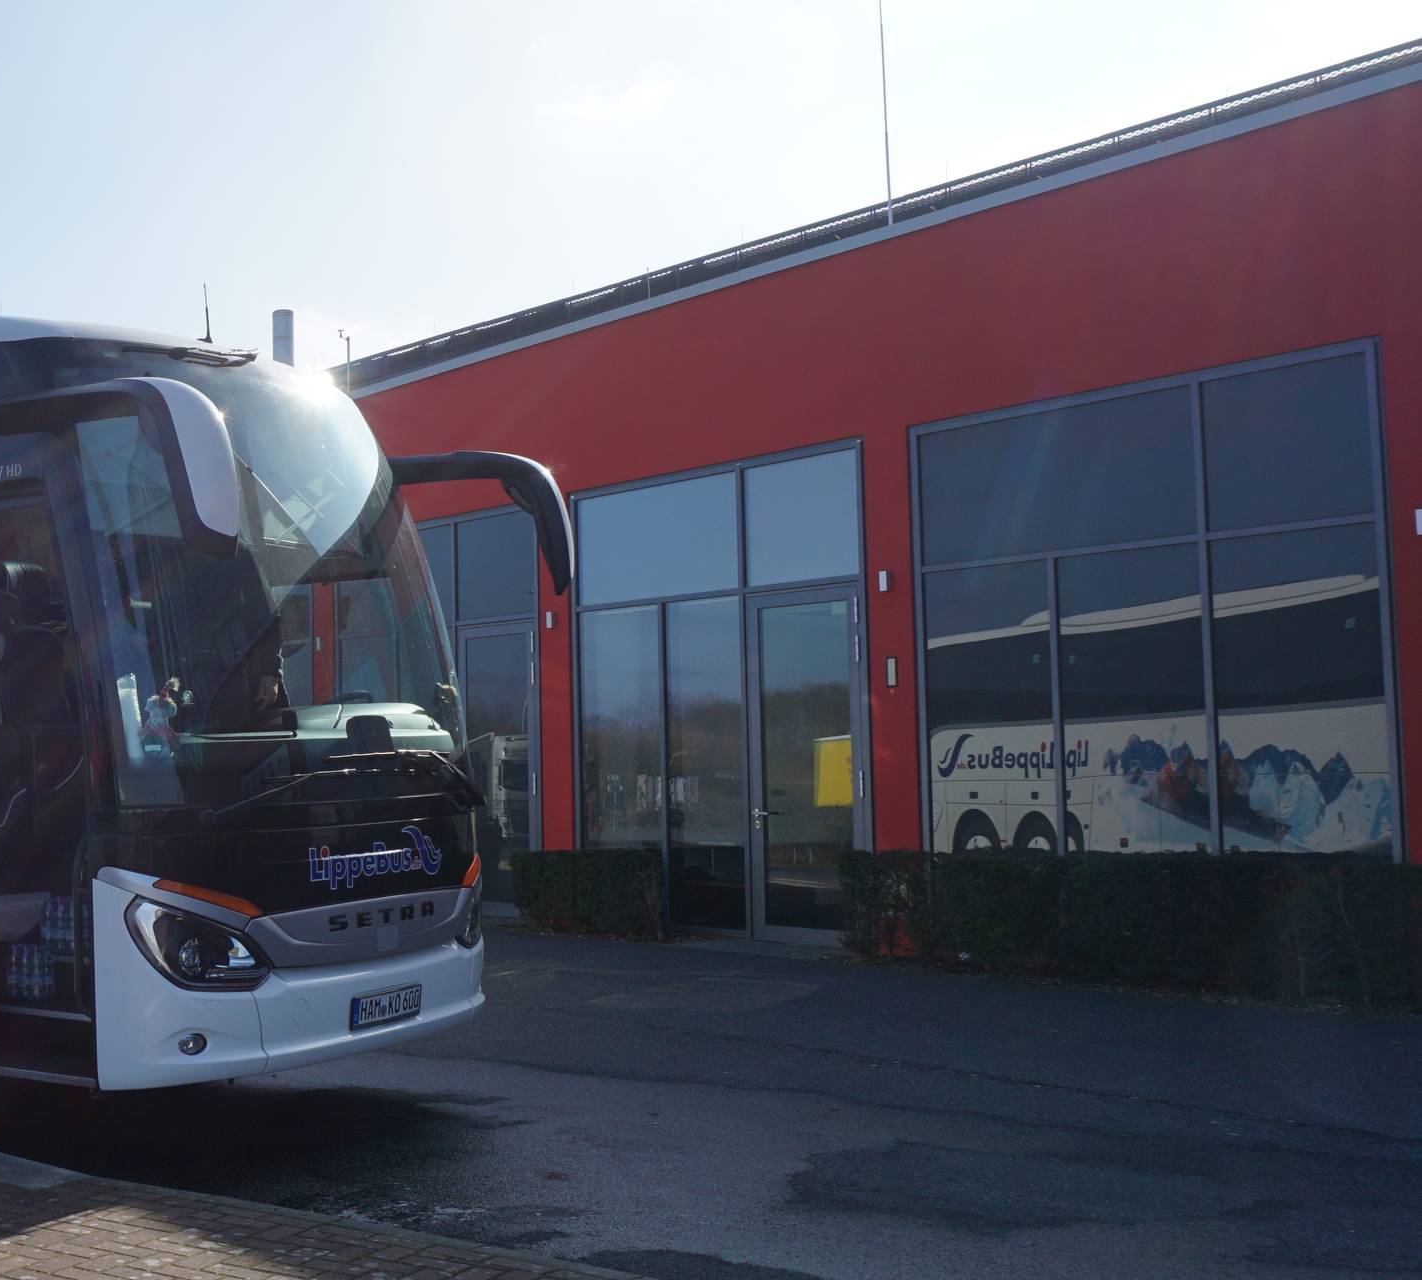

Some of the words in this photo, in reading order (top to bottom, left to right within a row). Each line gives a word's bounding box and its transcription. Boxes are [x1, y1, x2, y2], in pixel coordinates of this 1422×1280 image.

[6, 463, 22, 478] HD
[328, 900, 435, 933] SETRA
[360, 999, 381, 1021] HAM
[388, 994, 401, 1015] KO
[402, 989, 420, 1011] 600
